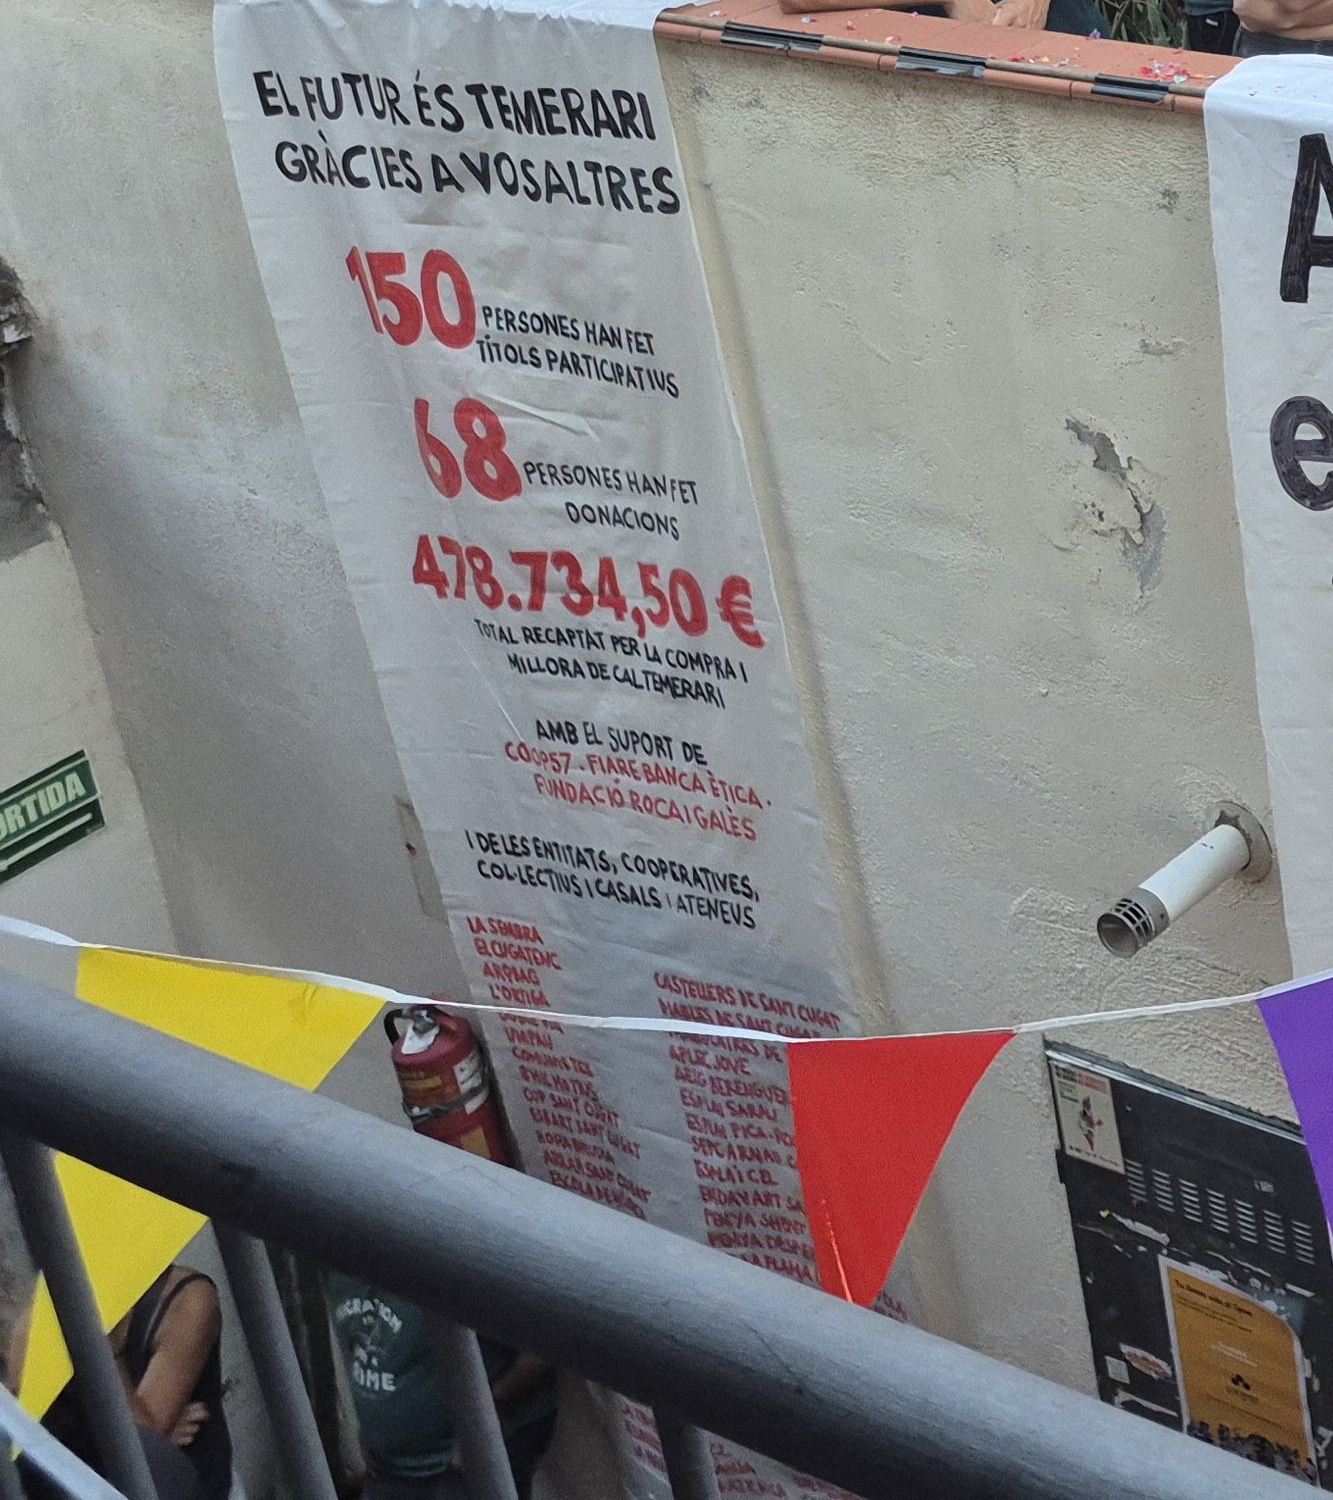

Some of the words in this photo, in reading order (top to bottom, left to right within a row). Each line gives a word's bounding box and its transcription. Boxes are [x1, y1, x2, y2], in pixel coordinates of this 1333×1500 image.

[253, 70, 300, 117] EL
[300, 71, 411, 126] FUTUR
[413, 69, 465, 132] ÉS
[465, 83, 657, 140] TEMERARI
[275, 129, 423, 194] GRÀCIES
[431, 153, 465, 194] A
[459, 151, 680, 214] VOSALTRES
[345, 245, 477, 349] 150
[482, 305, 580, 341] PERSONES
[584, 320, 622, 350] HAN
[624, 327, 656, 356] FET
[476, 333, 542, 370] TÍTOLS
[546, 348, 680, 399] PARTICIPATIUS
[414, 396, 523, 502] 68
[523, 460, 622, 492] PERSONES
[625, 470, 669, 498] HAN
[669, 478, 699, 505] FET
[565, 501, 680, 541] DONACIONS
[412, 533, 709, 639] 478.734,50
[473, 617, 519, 645] TOTAL
[522, 625, 606, 651] RECAPTAT
[609, 633, 641, 658] PER
[643, 642, 662, 666] LA
[664, 647, 736, 683] COMPRA
[507, 652, 587, 681] MILLORA
[589, 659, 611, 681] DE
[535, 718, 579, 746] AMB
[583, 720, 604, 746] EL
[607, 726, 674, 761] SUPORT
[681, 741, 709, 767] DE
[586, 752, 642, 781] FIARE
[642, 762, 706, 795] BANCA
[629, 788, 686, 823] ROCA
[499, 832, 531, 858] LES
[533, 837, 619, 876] ENTITATS,
[620, 852, 760, 902] COOPERATIVES,
[594, 877, 663, 909] CASALS
[676, 893, 757, 930] ATENEUS
